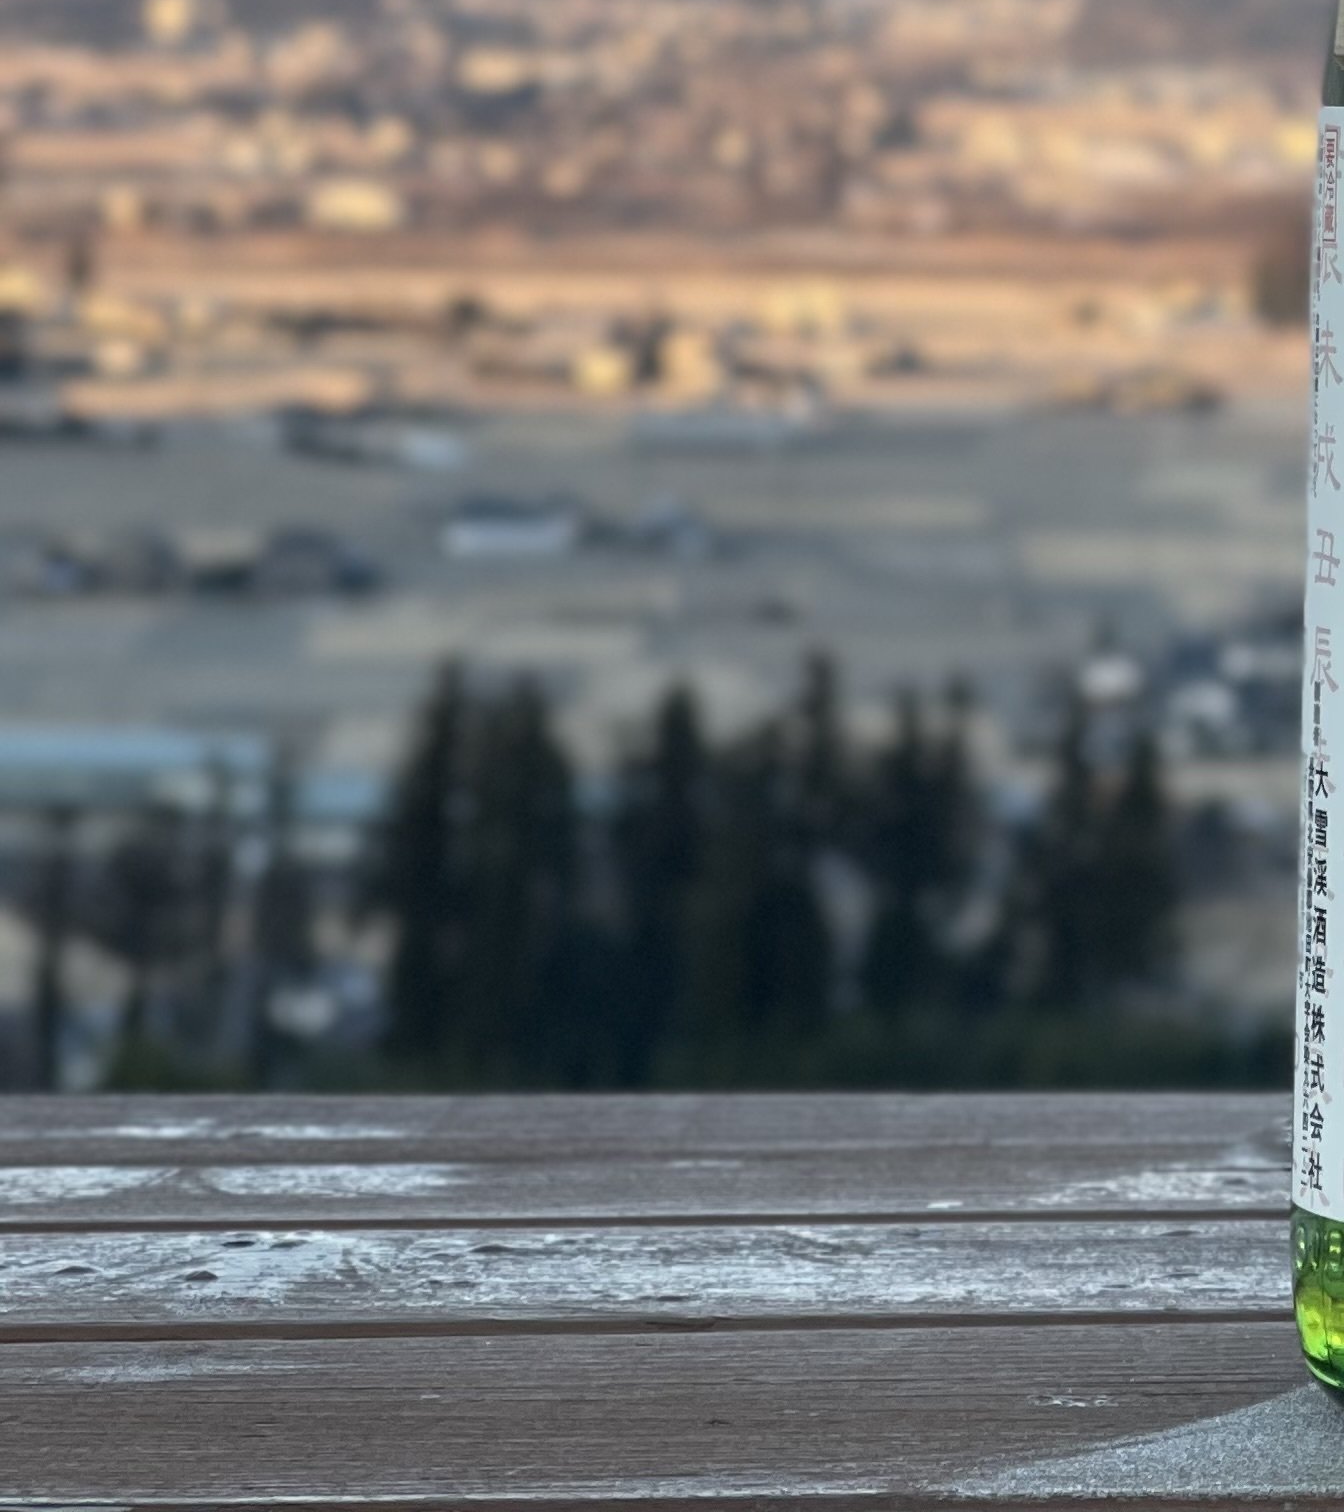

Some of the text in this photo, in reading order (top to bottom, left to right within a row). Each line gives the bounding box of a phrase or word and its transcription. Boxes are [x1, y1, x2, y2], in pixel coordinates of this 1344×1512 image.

[1307, 765, 1329, 1191] 大雪渓酒造株式会社
